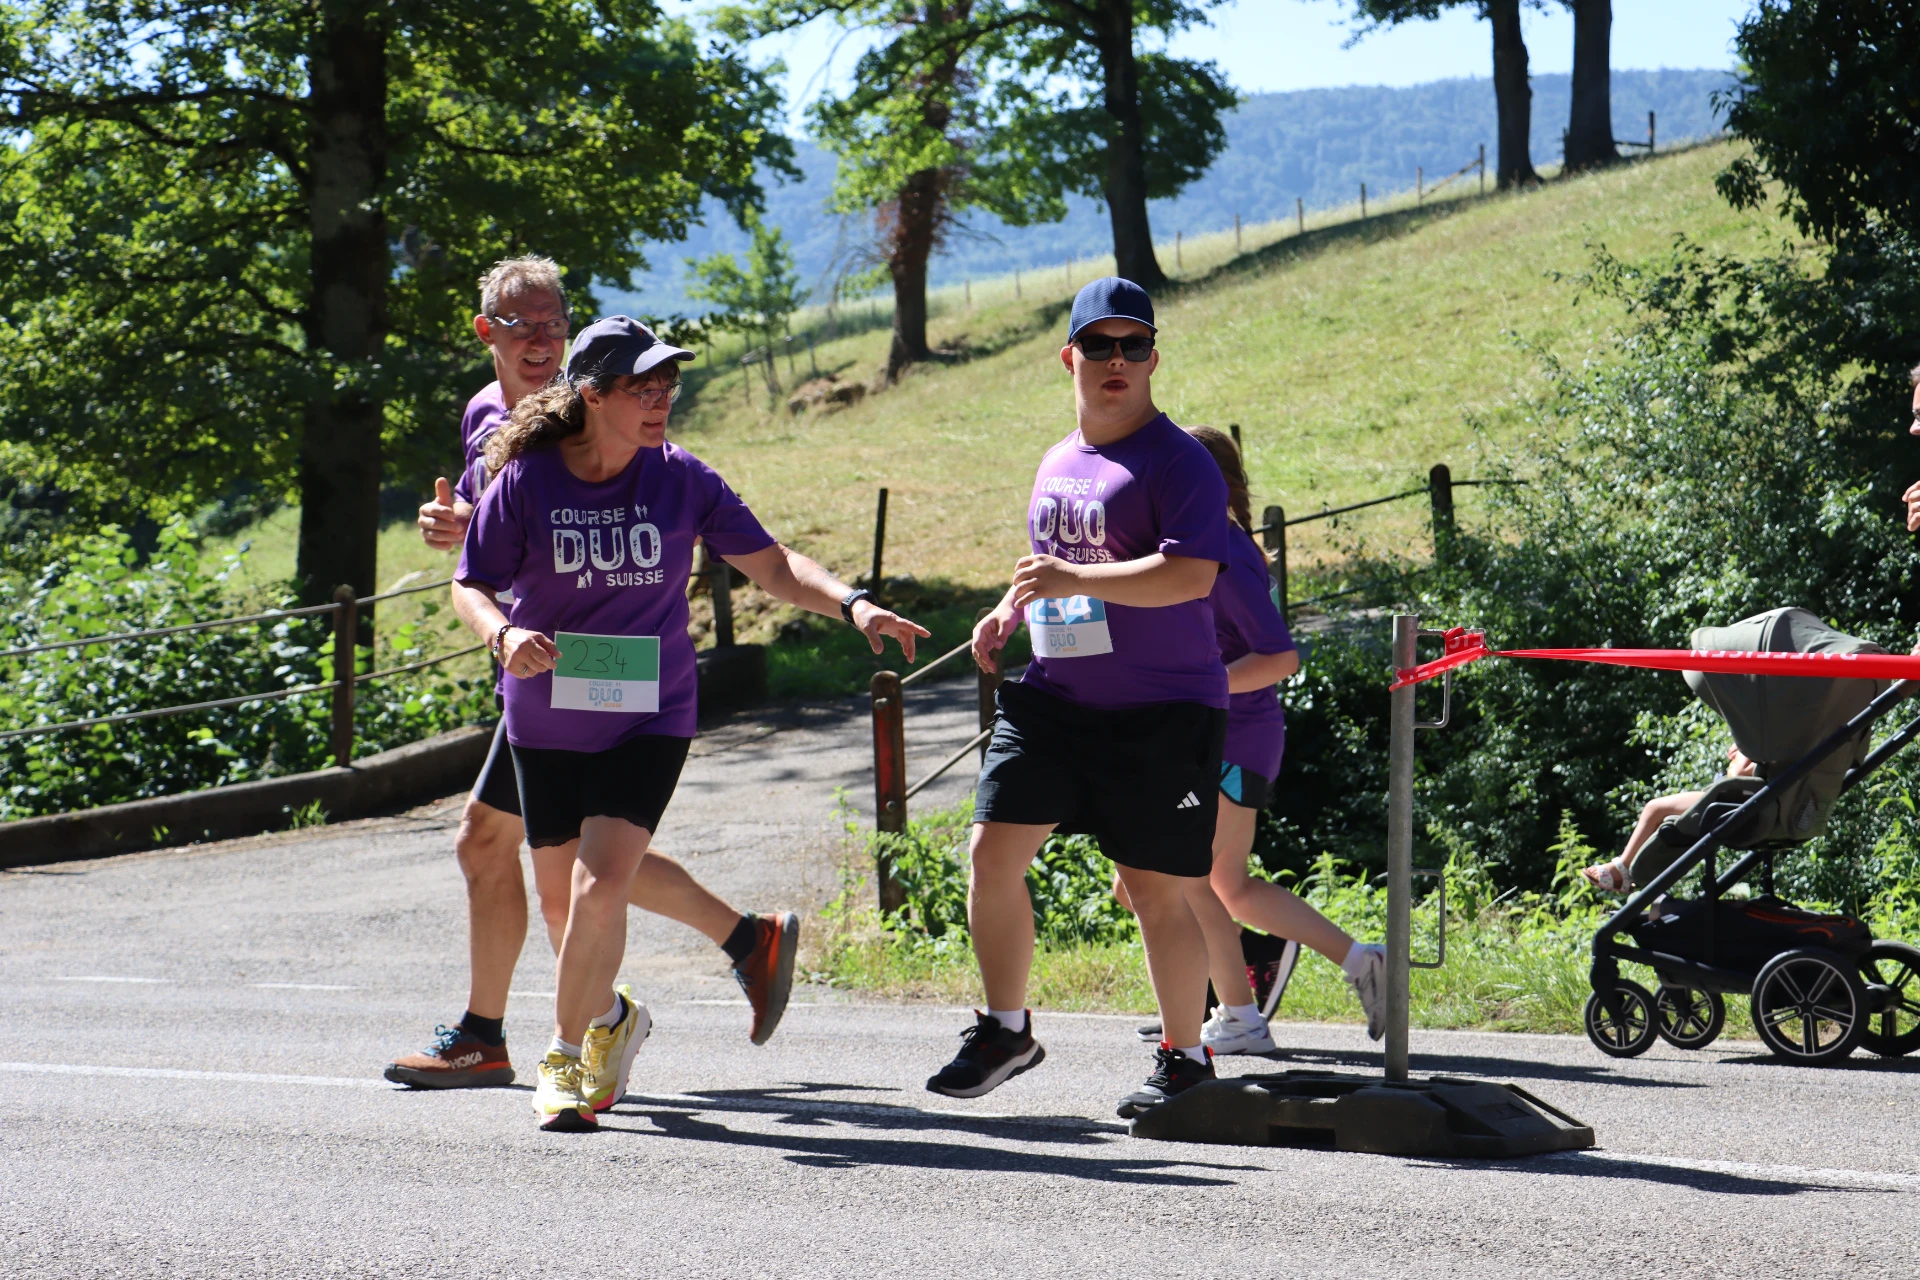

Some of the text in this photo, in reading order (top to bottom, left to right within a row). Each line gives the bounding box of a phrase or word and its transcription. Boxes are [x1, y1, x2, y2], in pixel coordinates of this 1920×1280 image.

[1040, 476, 1092, 496] COURSE
[550, 507, 626, 525] COURSE
[1033, 497, 1106, 546] DUO
[553, 522, 662, 573] DUO
[1066, 546, 1115, 563] SUISSE
[605, 568, 664, 587] SUISSE
[1048, 633, 1077, 647] DUO
[570, 639, 628, 674] 234
[588, 687, 623, 703] DUO
[448, 1051, 483, 1070] HOKA
